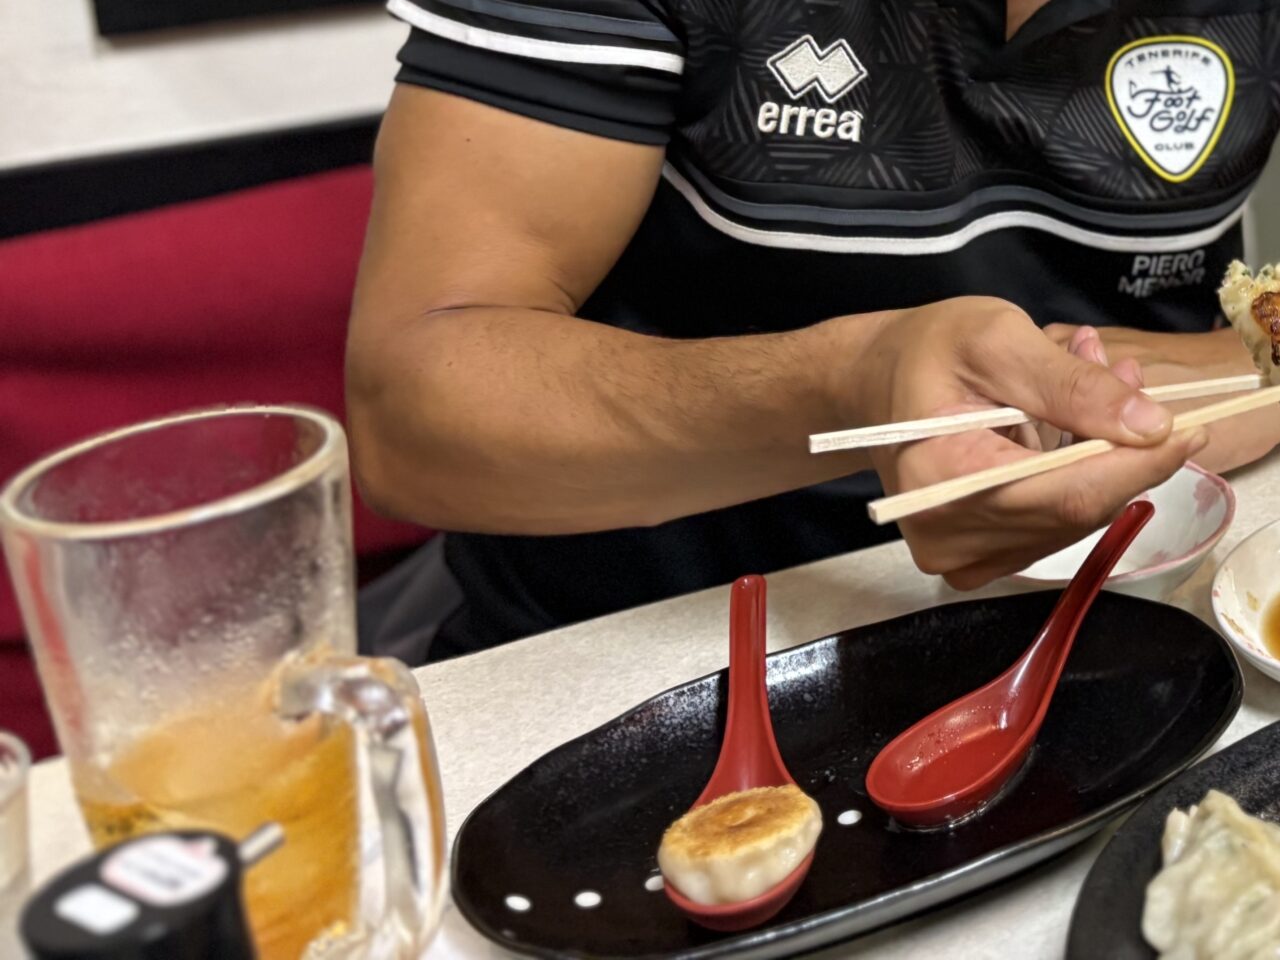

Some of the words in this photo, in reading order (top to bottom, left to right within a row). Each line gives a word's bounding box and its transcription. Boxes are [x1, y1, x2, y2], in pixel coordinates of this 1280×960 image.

[1125, 48, 1212, 68] TENERIFE
[1154, 142, 1196, 152] CLUB
[1131, 249, 1206, 277] PIERO
